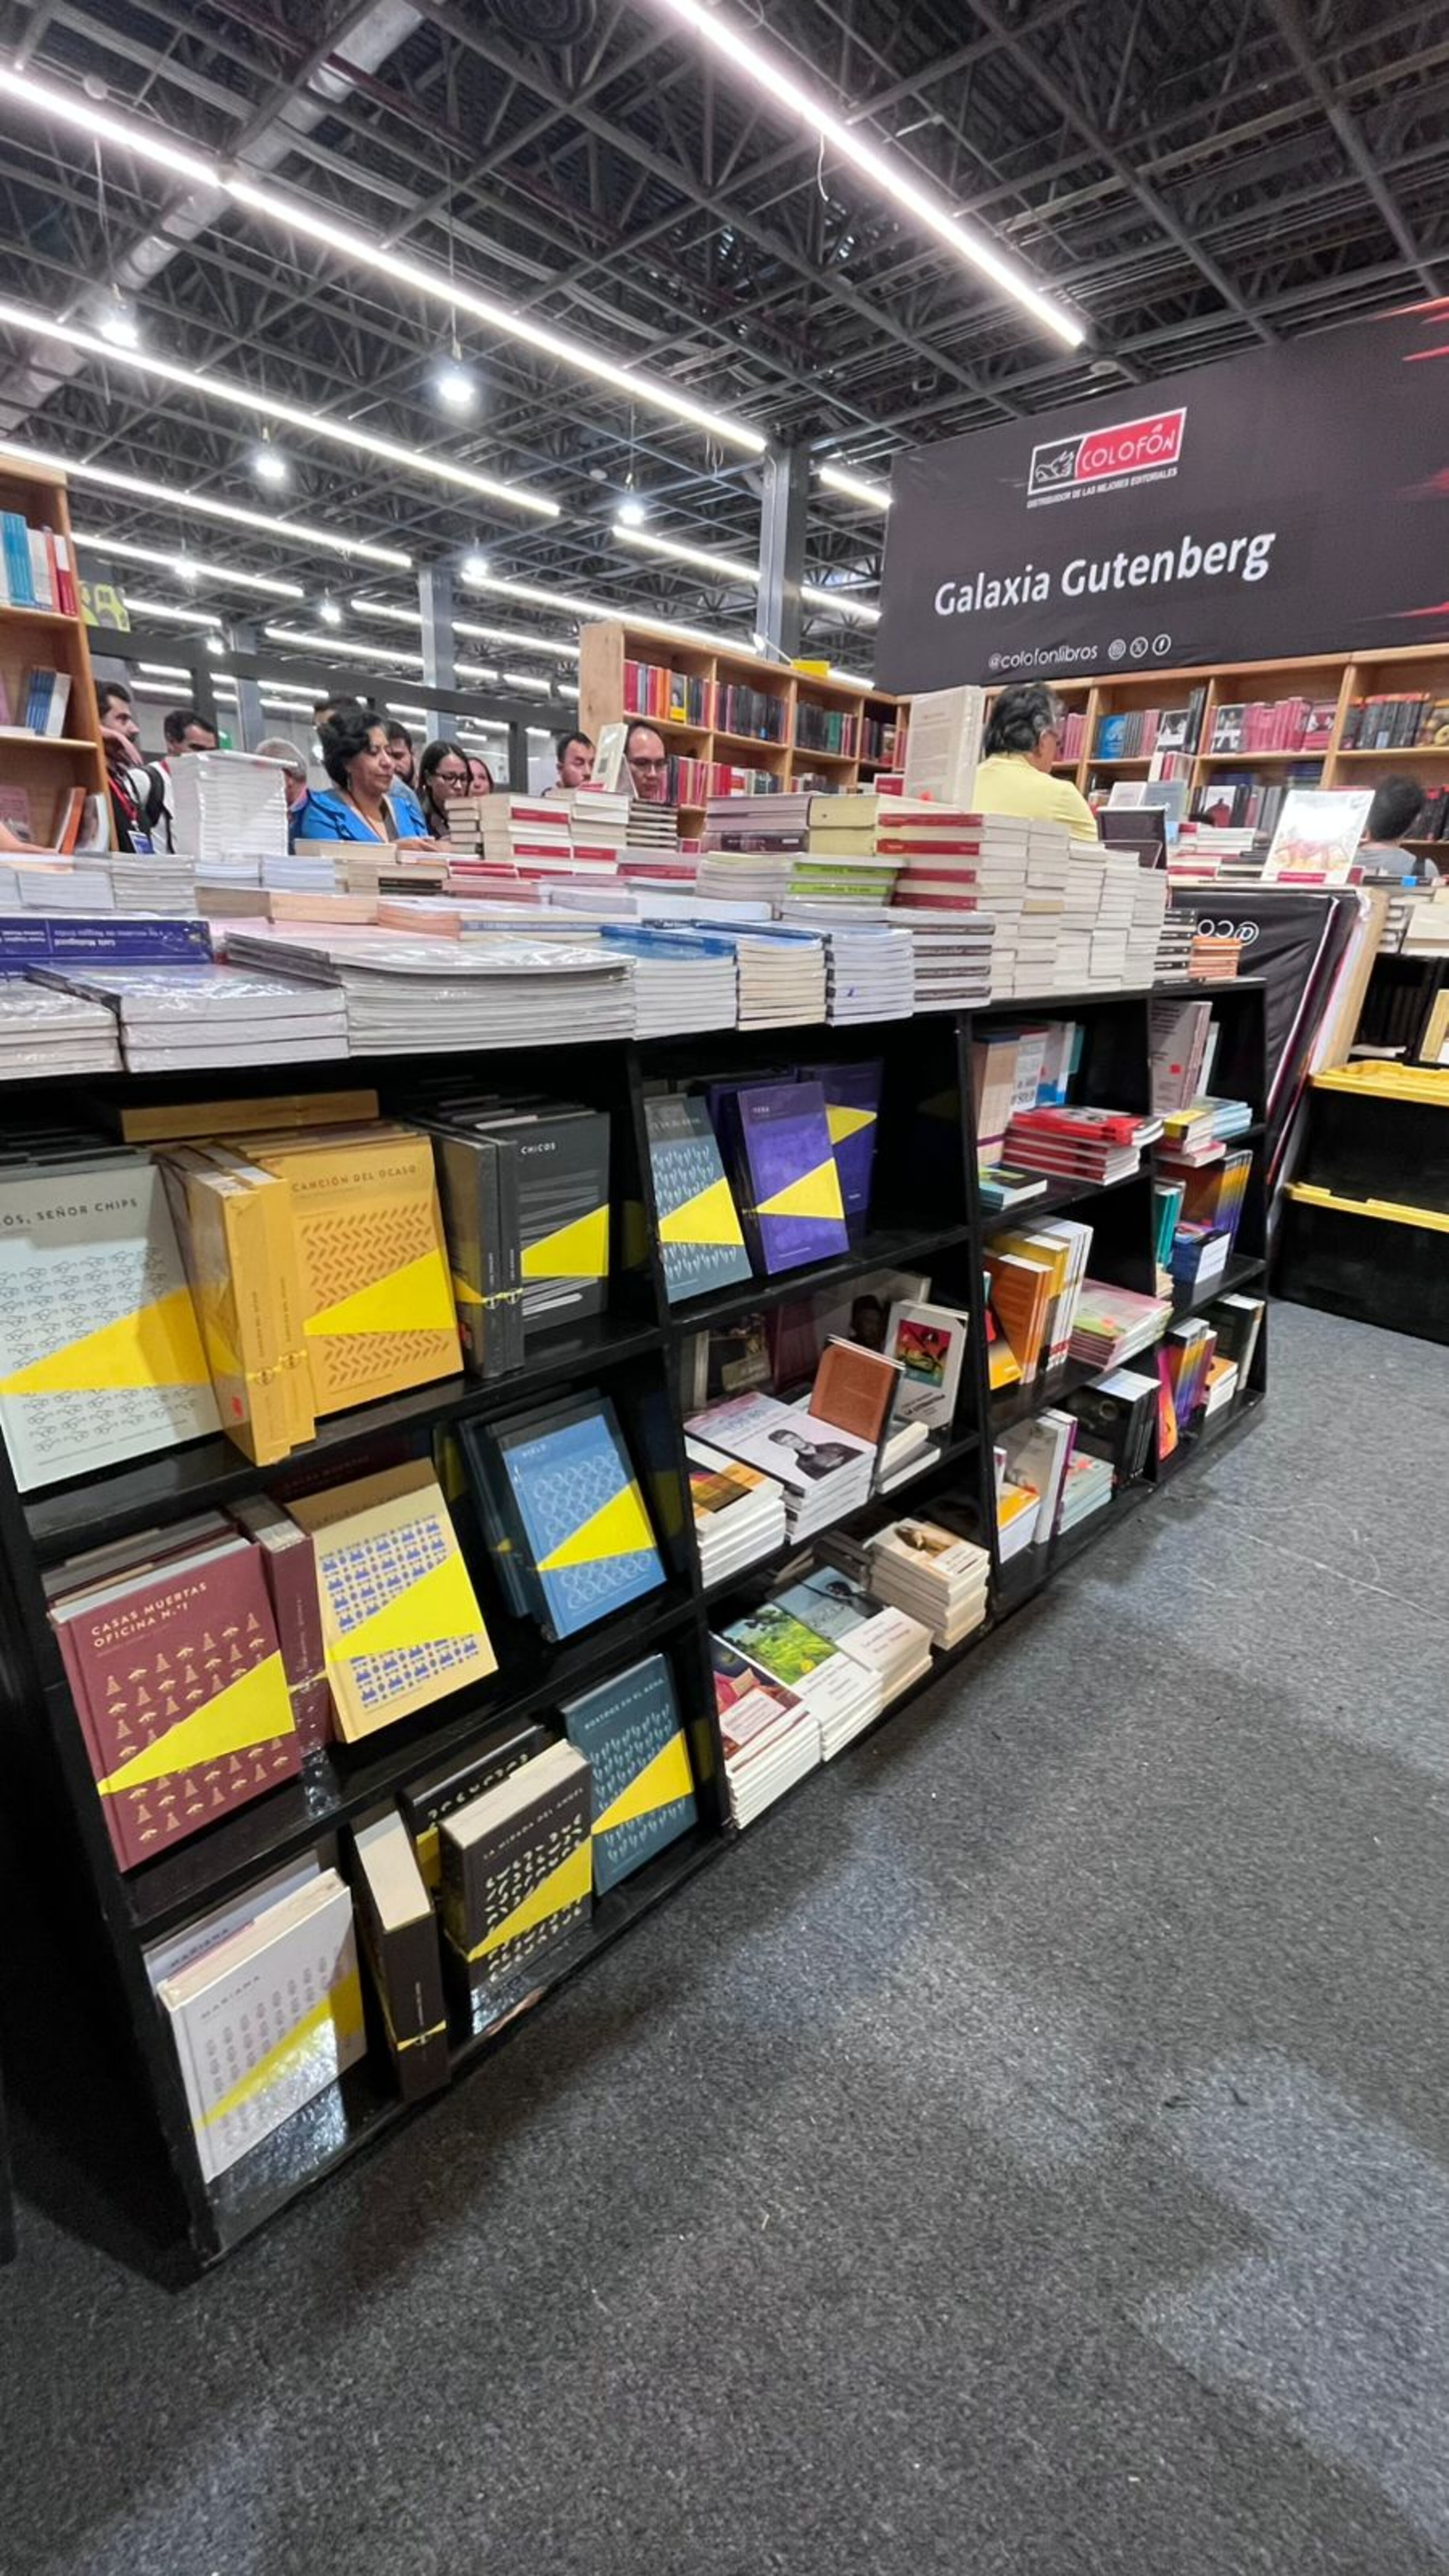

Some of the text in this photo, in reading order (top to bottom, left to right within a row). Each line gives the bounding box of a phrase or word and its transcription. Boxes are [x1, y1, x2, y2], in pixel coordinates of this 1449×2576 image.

[1082, 423, 1176, 471] COLOFÓN
[935, 533, 1276, 616] Galaxia Gutenberg
[988, 644, 1098, 670] @colofonlibros
[353, 1172, 374, 1182] DEL
[378, 1165, 416, 1177] OCASO
[37, 1204, 88, 1221] SEÑOR
[94, 1198, 138, 1212] CHIPS
[91, 1582, 206, 1635] CASAS MUERTAS
[94, 1617, 156, 1647] OFICINA
